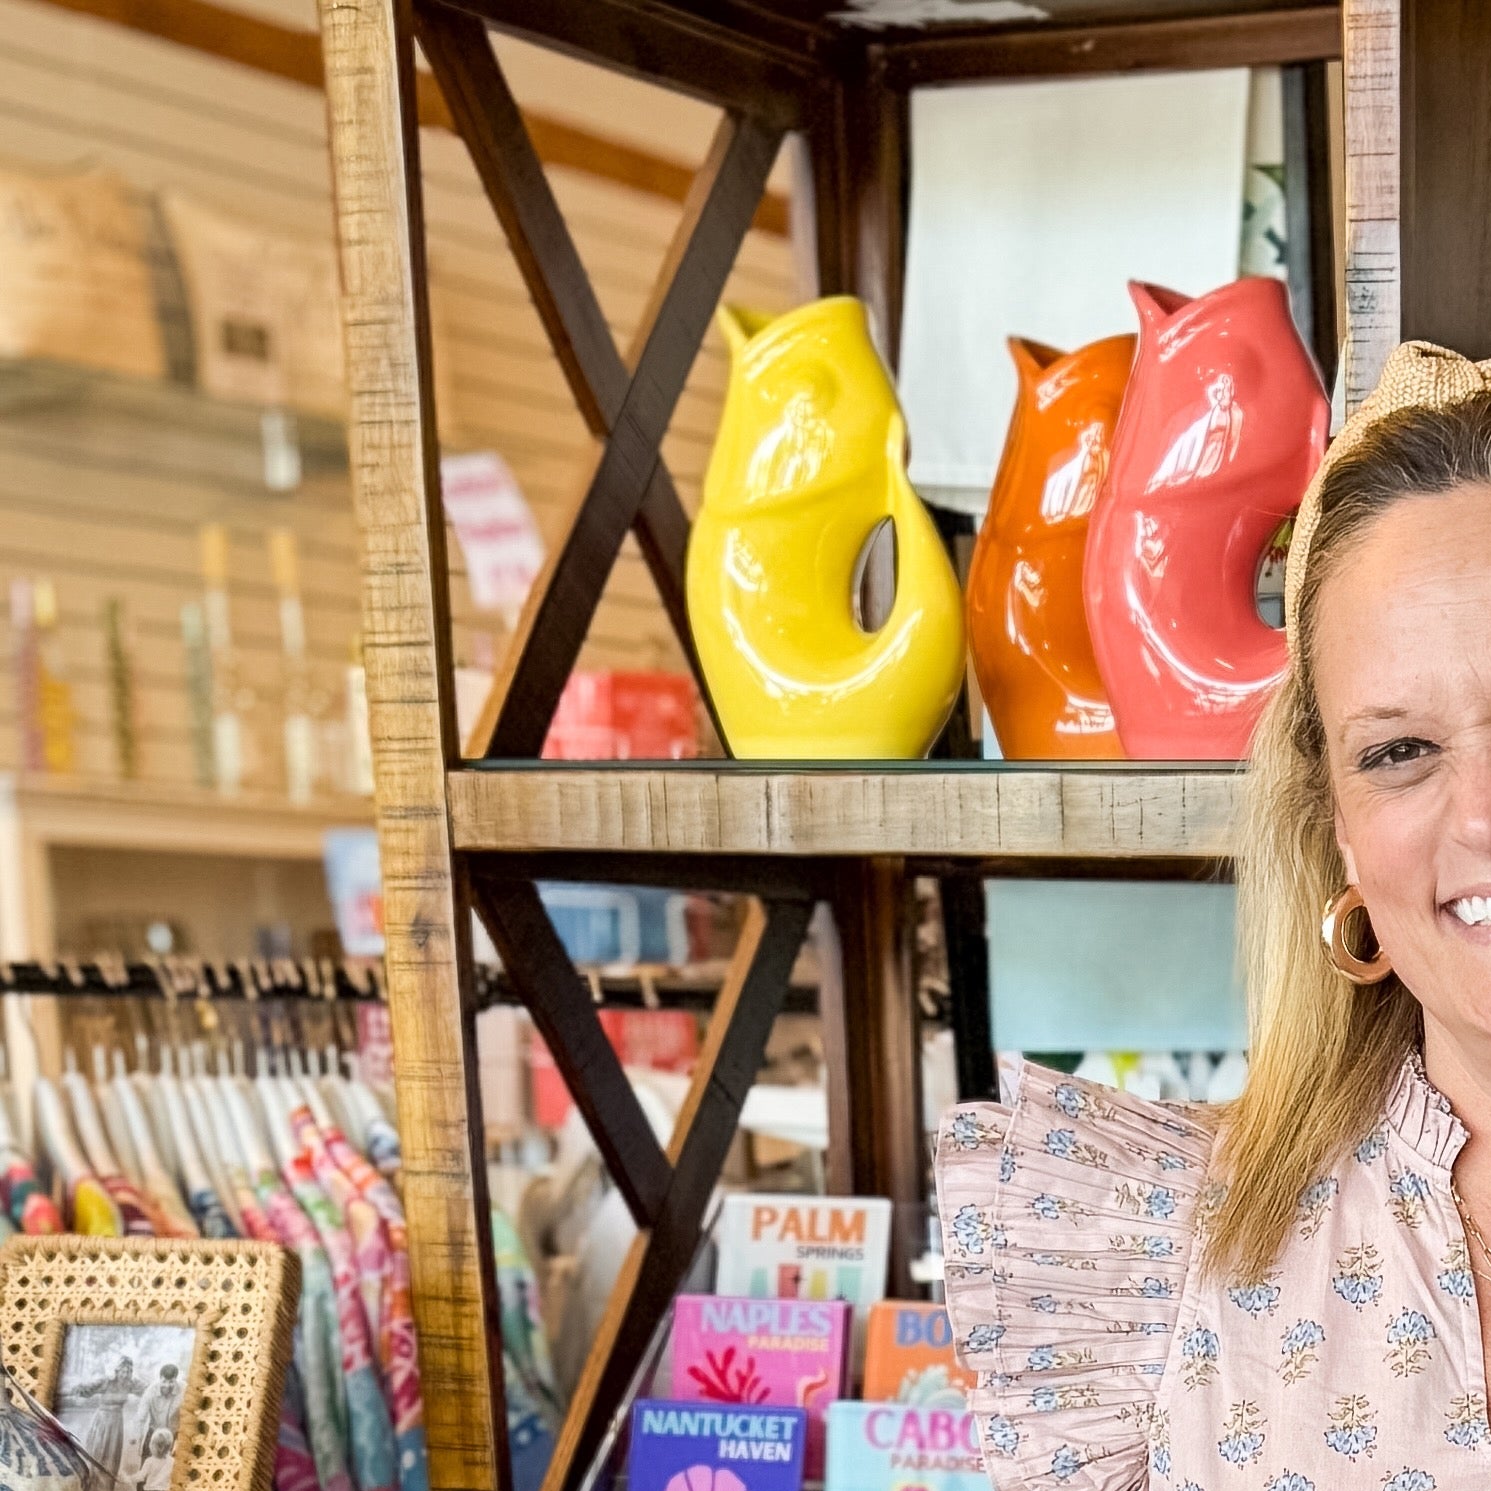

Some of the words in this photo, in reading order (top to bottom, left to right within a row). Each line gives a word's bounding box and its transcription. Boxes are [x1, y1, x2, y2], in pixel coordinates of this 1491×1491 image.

[752, 1205, 866, 1244] PALM
[797, 1246, 864, 1261] SPRINGS
[702, 1302, 832, 1336] NAPLES
[895, 1309, 953, 1347] BO
[642, 1409, 798, 1440] NANTUCKET
[719, 1439, 792, 1462] HAVEN
[891, 1453, 986, 1473] PARADISE
